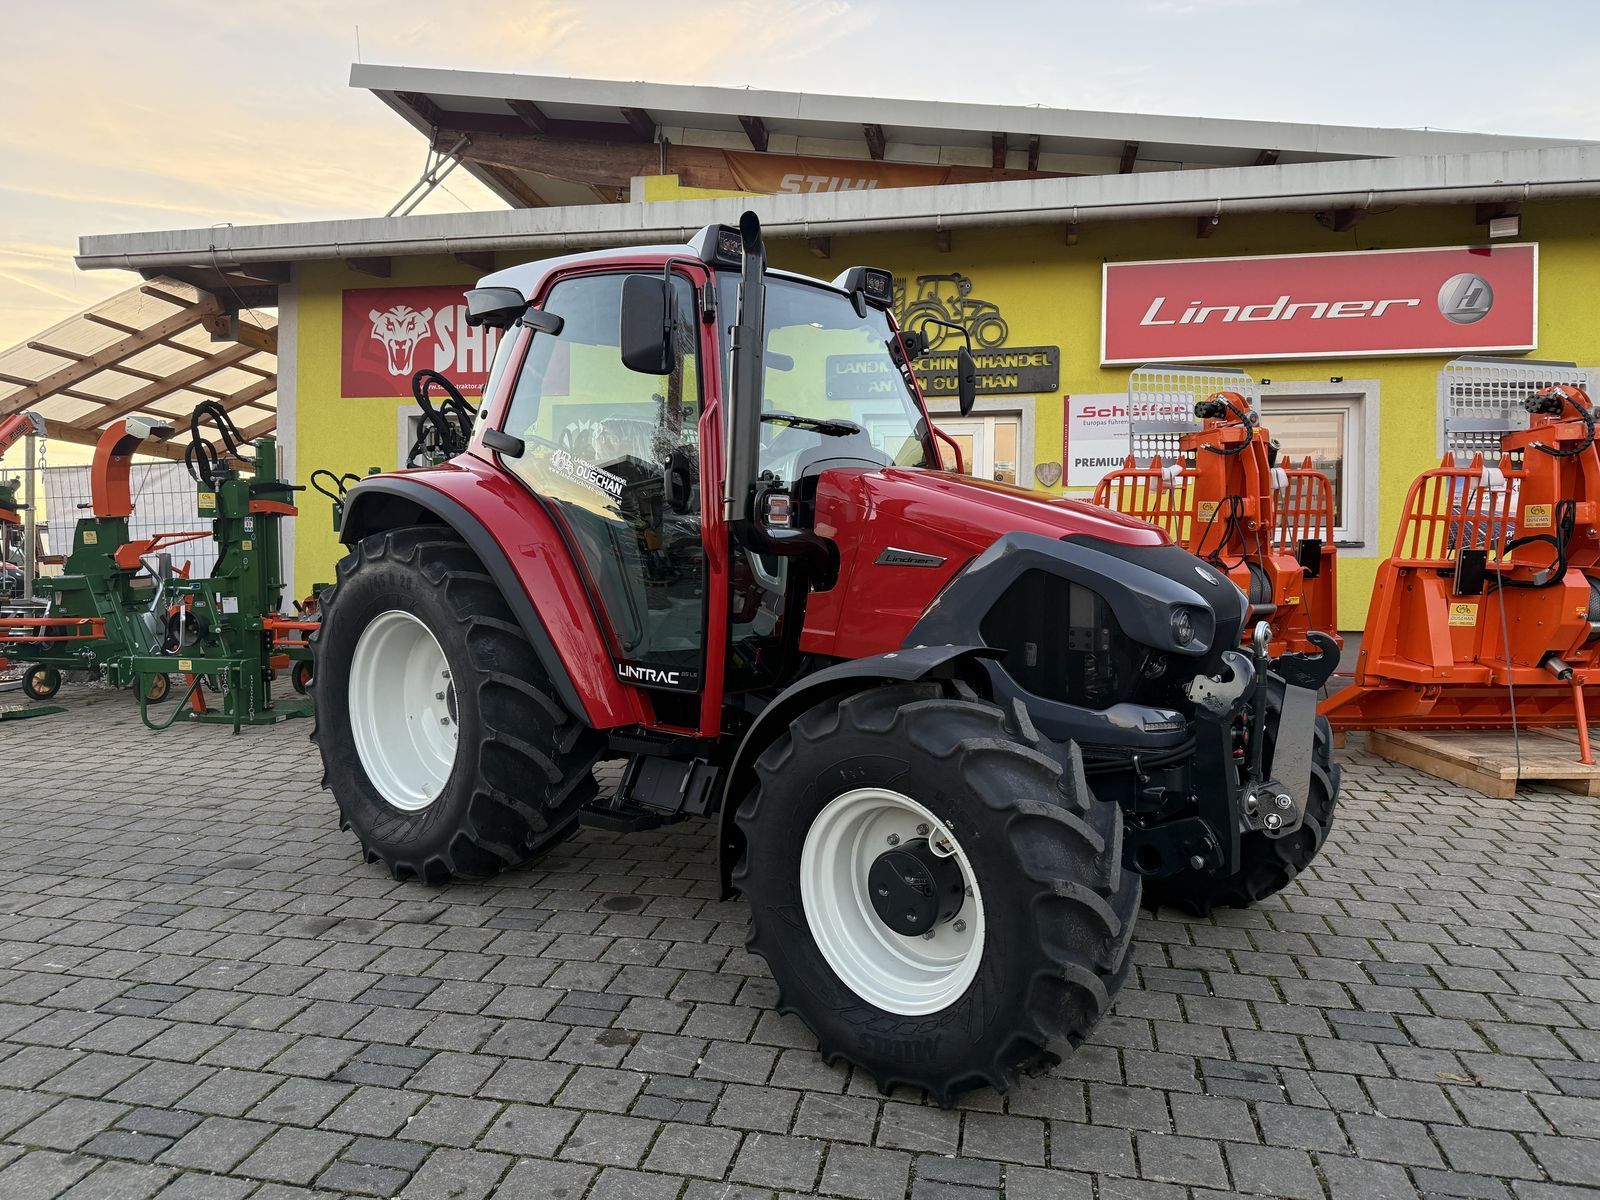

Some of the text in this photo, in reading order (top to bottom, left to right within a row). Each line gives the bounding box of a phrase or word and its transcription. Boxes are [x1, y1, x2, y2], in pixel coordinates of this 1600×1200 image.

[1139, 295, 1421, 326] Lindner
[1083, 419, 1107, 427] Europas
[576, 465, 623, 495] OUSCHAN
[885, 554, 933, 564] Lindner
[619, 663, 679, 684] LINTRAC
